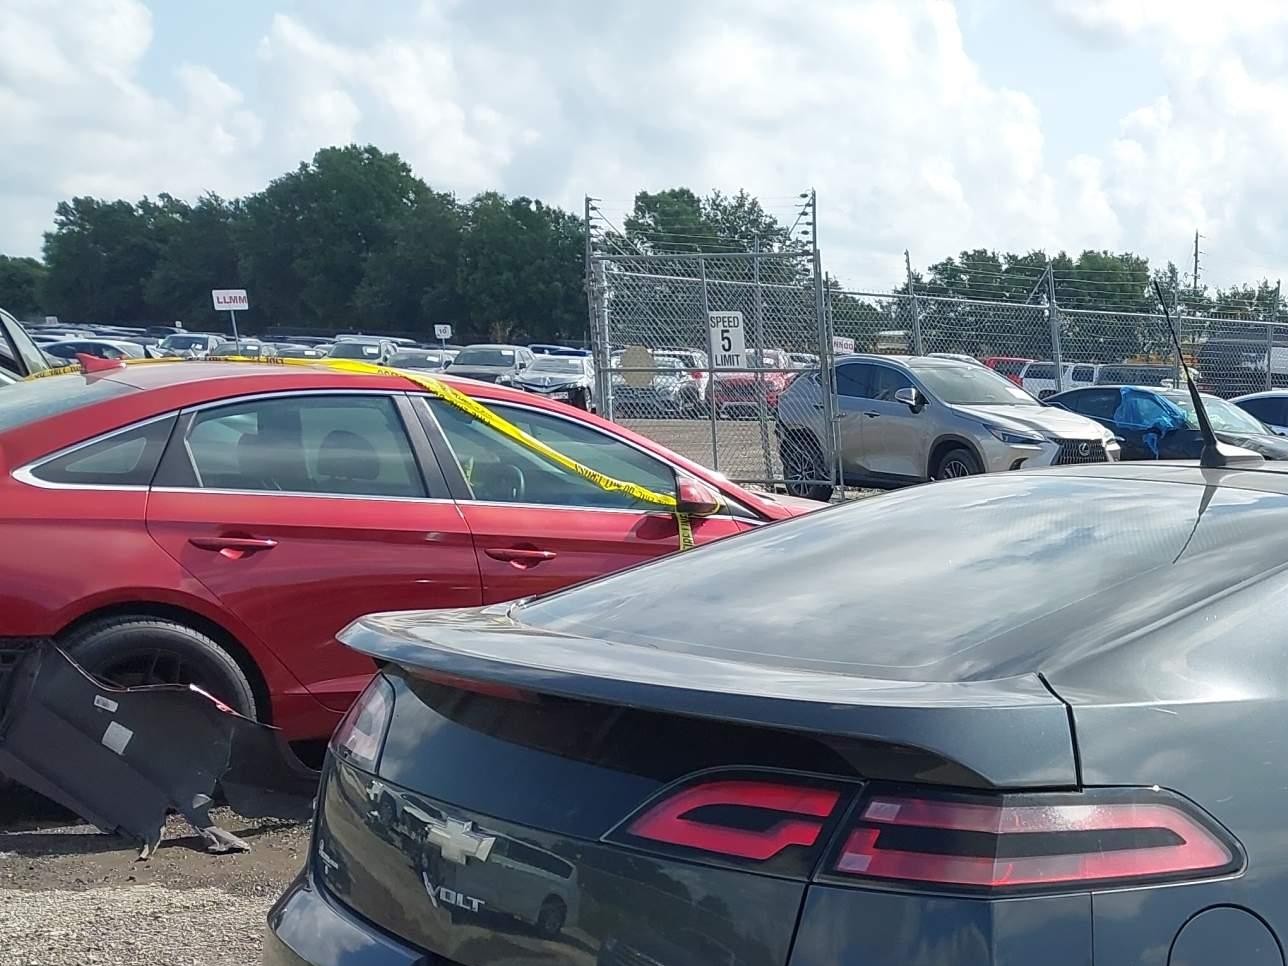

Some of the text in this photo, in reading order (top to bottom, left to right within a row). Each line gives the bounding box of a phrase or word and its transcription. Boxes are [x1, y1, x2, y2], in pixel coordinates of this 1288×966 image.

[216, 295, 248, 304] LLMM
[710, 316, 739, 328] SPEED
[721, 329, 732, 352] 5
[715, 354, 740, 366] LIMIT
[422, 871, 486, 912] VOLT
